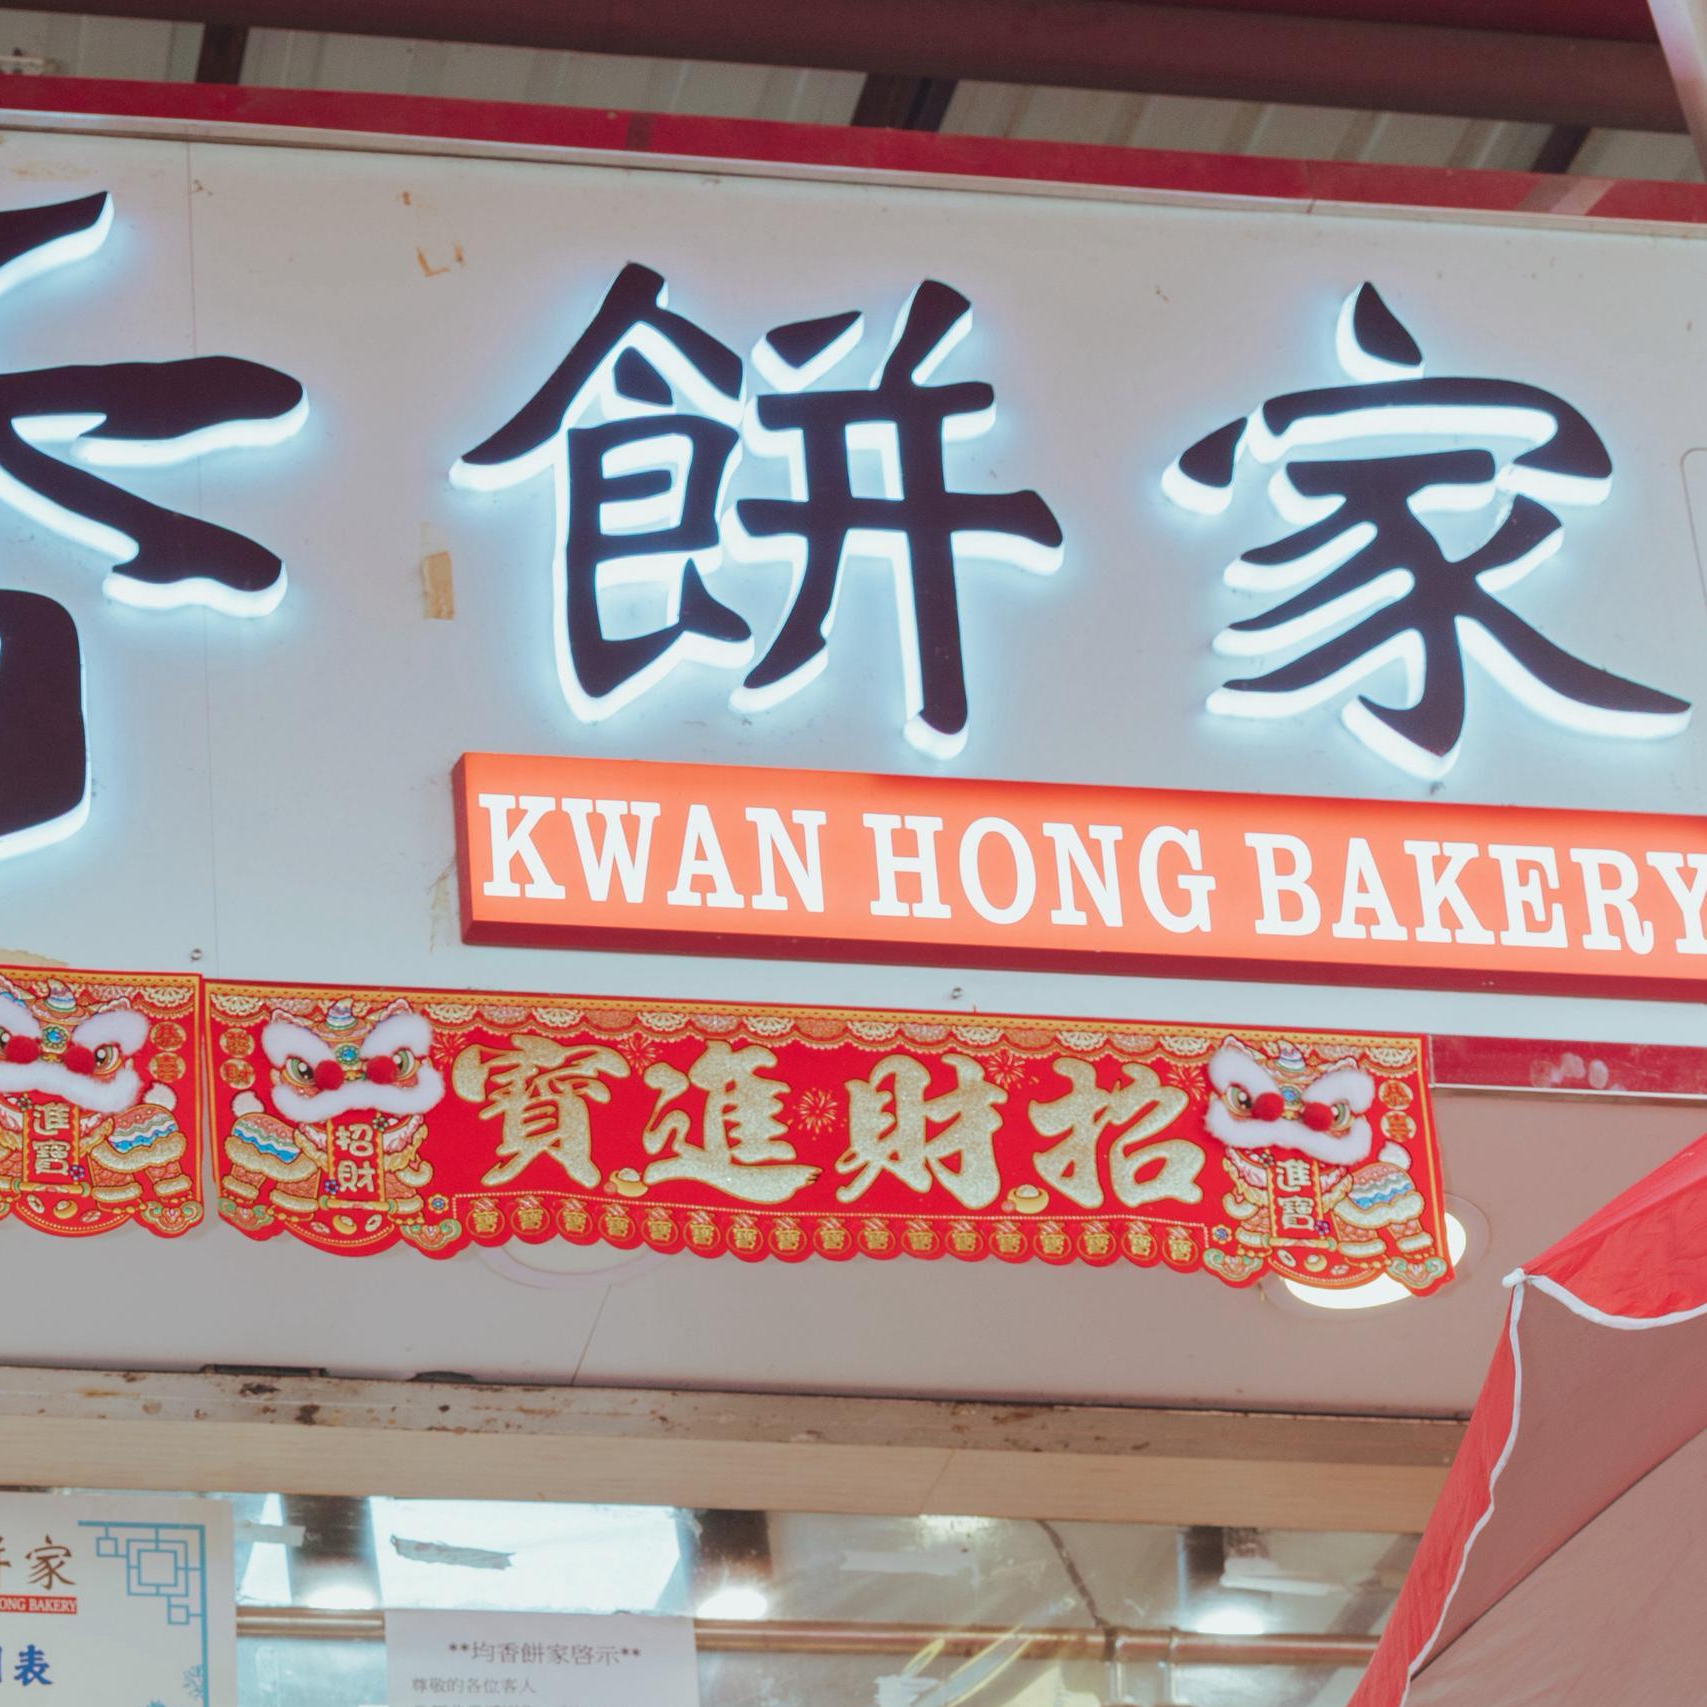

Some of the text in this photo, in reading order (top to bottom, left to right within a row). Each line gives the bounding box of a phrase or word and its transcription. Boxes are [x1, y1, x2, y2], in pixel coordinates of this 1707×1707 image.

[479, 793, 825, 913] KWAN
[862, 813, 1215, 932] HONG
[29, 1598, 76, 1613] BAKERY
